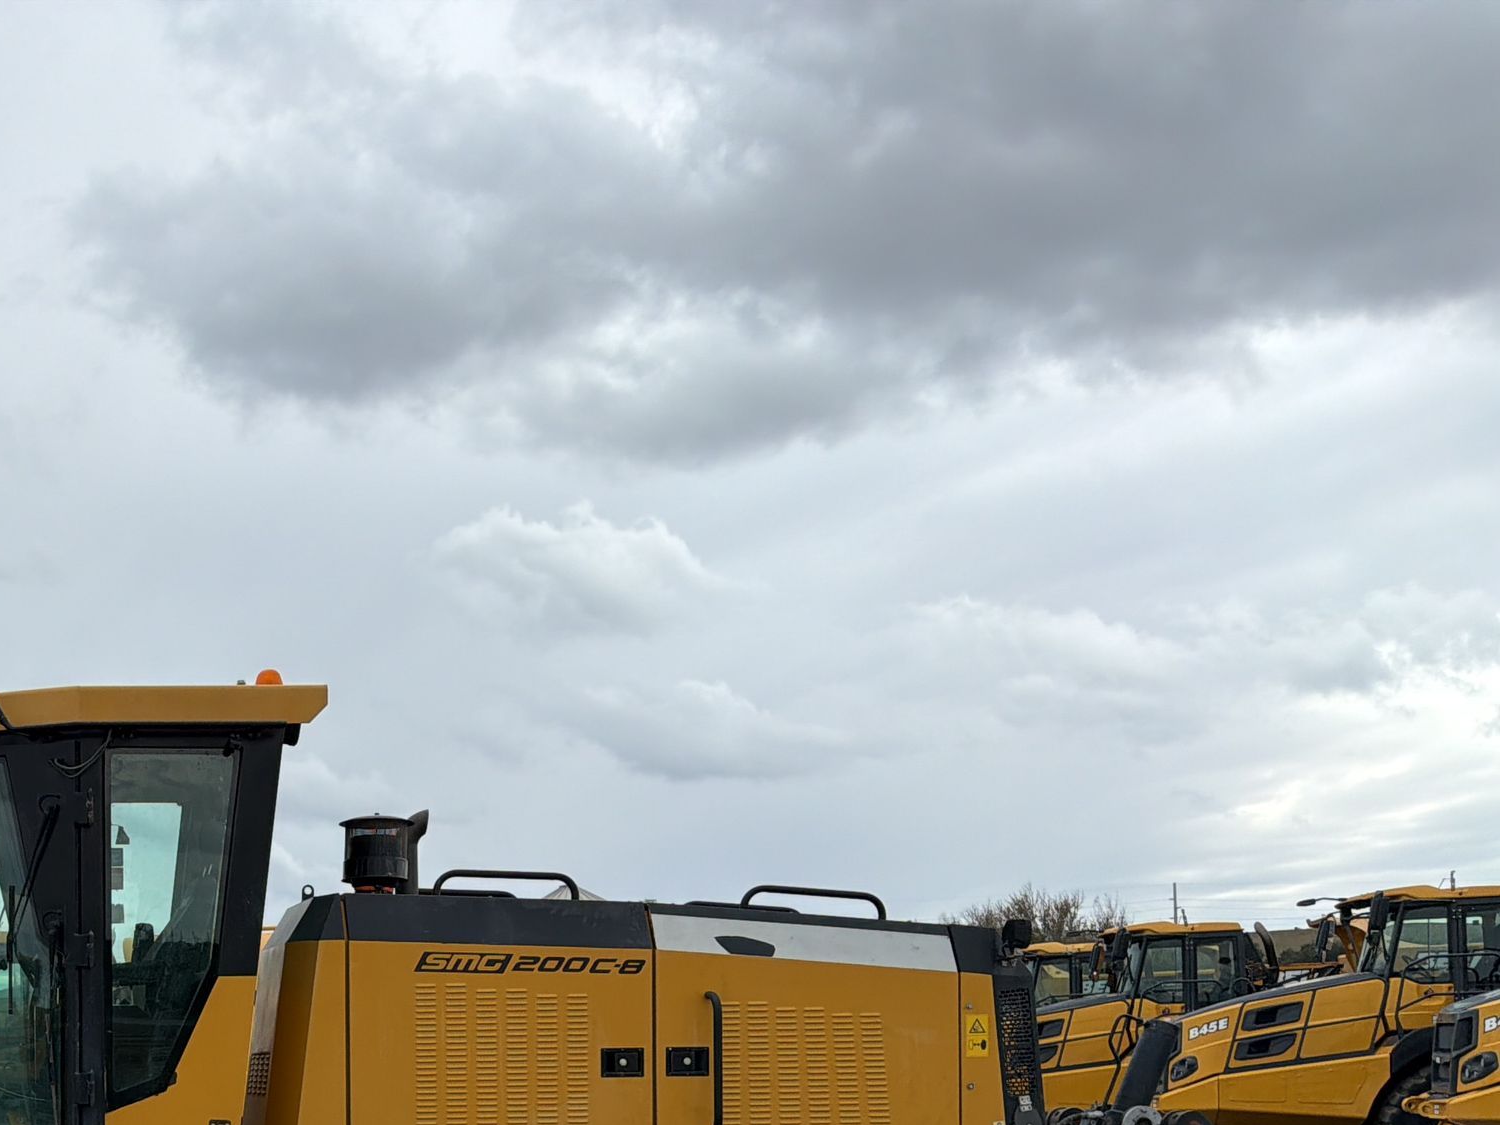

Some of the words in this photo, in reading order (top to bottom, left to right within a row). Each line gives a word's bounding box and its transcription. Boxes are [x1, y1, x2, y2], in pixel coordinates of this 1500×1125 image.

[414, 951, 513, 974] SMG
[512, 955, 647, 975] 200C-8
[1188, 1017, 1229, 1040] B45E
[1484, 1015, 1500, 1033] B
